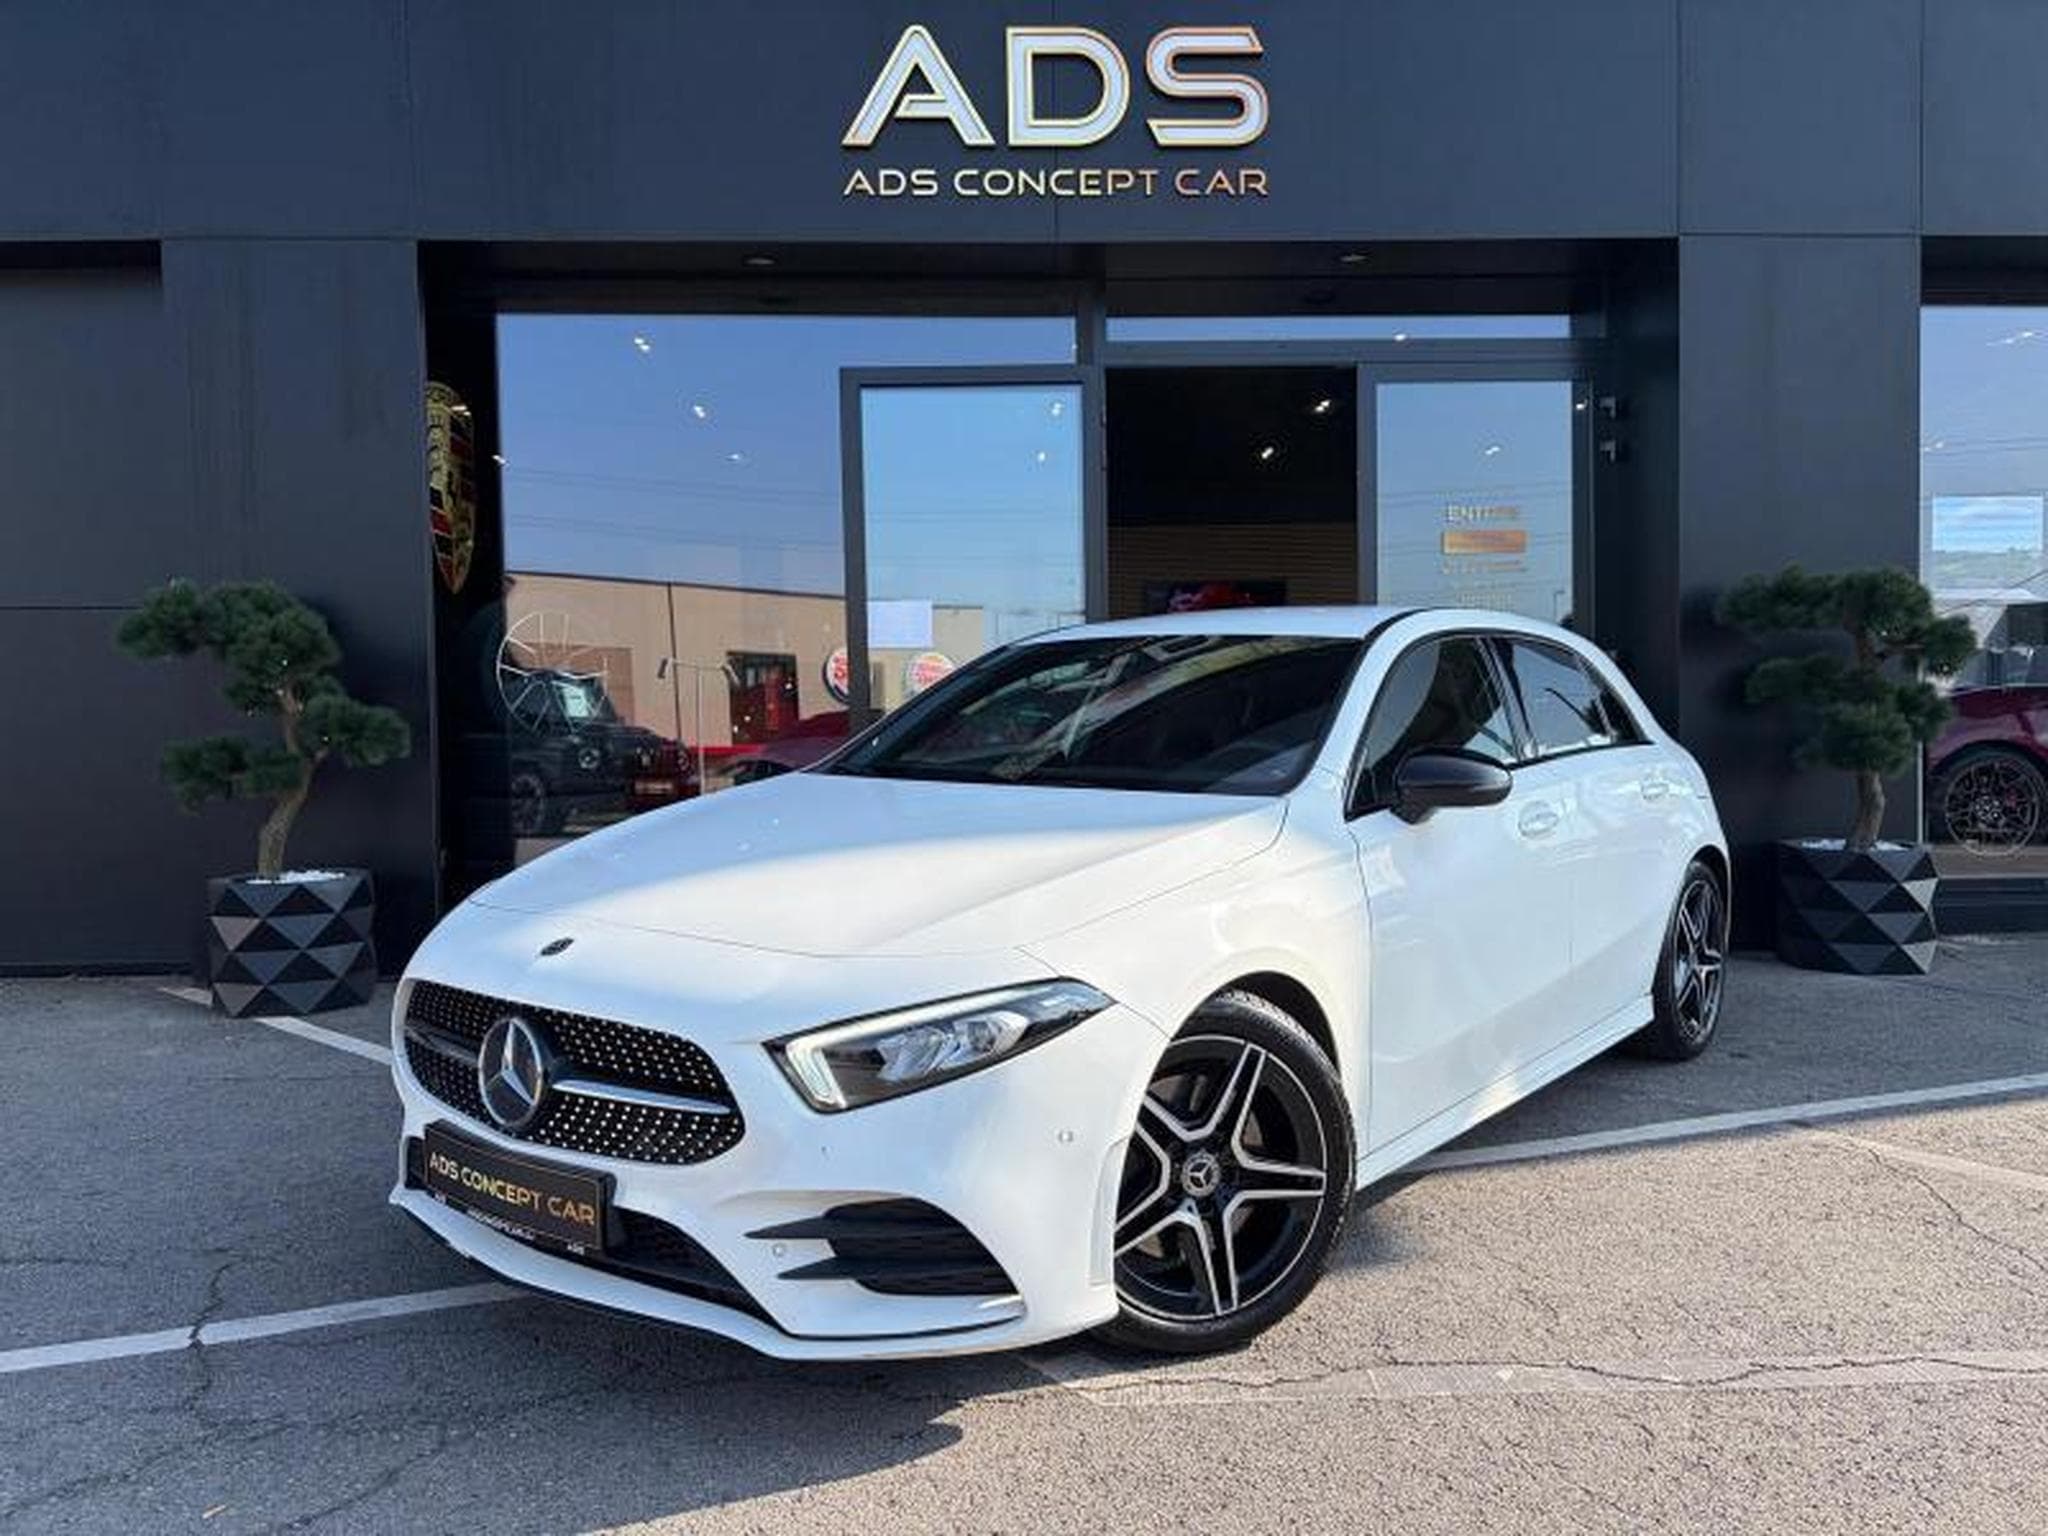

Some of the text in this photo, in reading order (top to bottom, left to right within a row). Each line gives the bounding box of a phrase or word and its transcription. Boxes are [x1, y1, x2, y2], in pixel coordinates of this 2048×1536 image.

[842, 24, 1269, 147] ADS
[843, 168, 1269, 197] ADS CONCEPT CAR
[429, 1152, 460, 1180] ADS
[461, 1166, 541, 1211] CONCEPT
[547, 1196, 595, 1226] CAR
